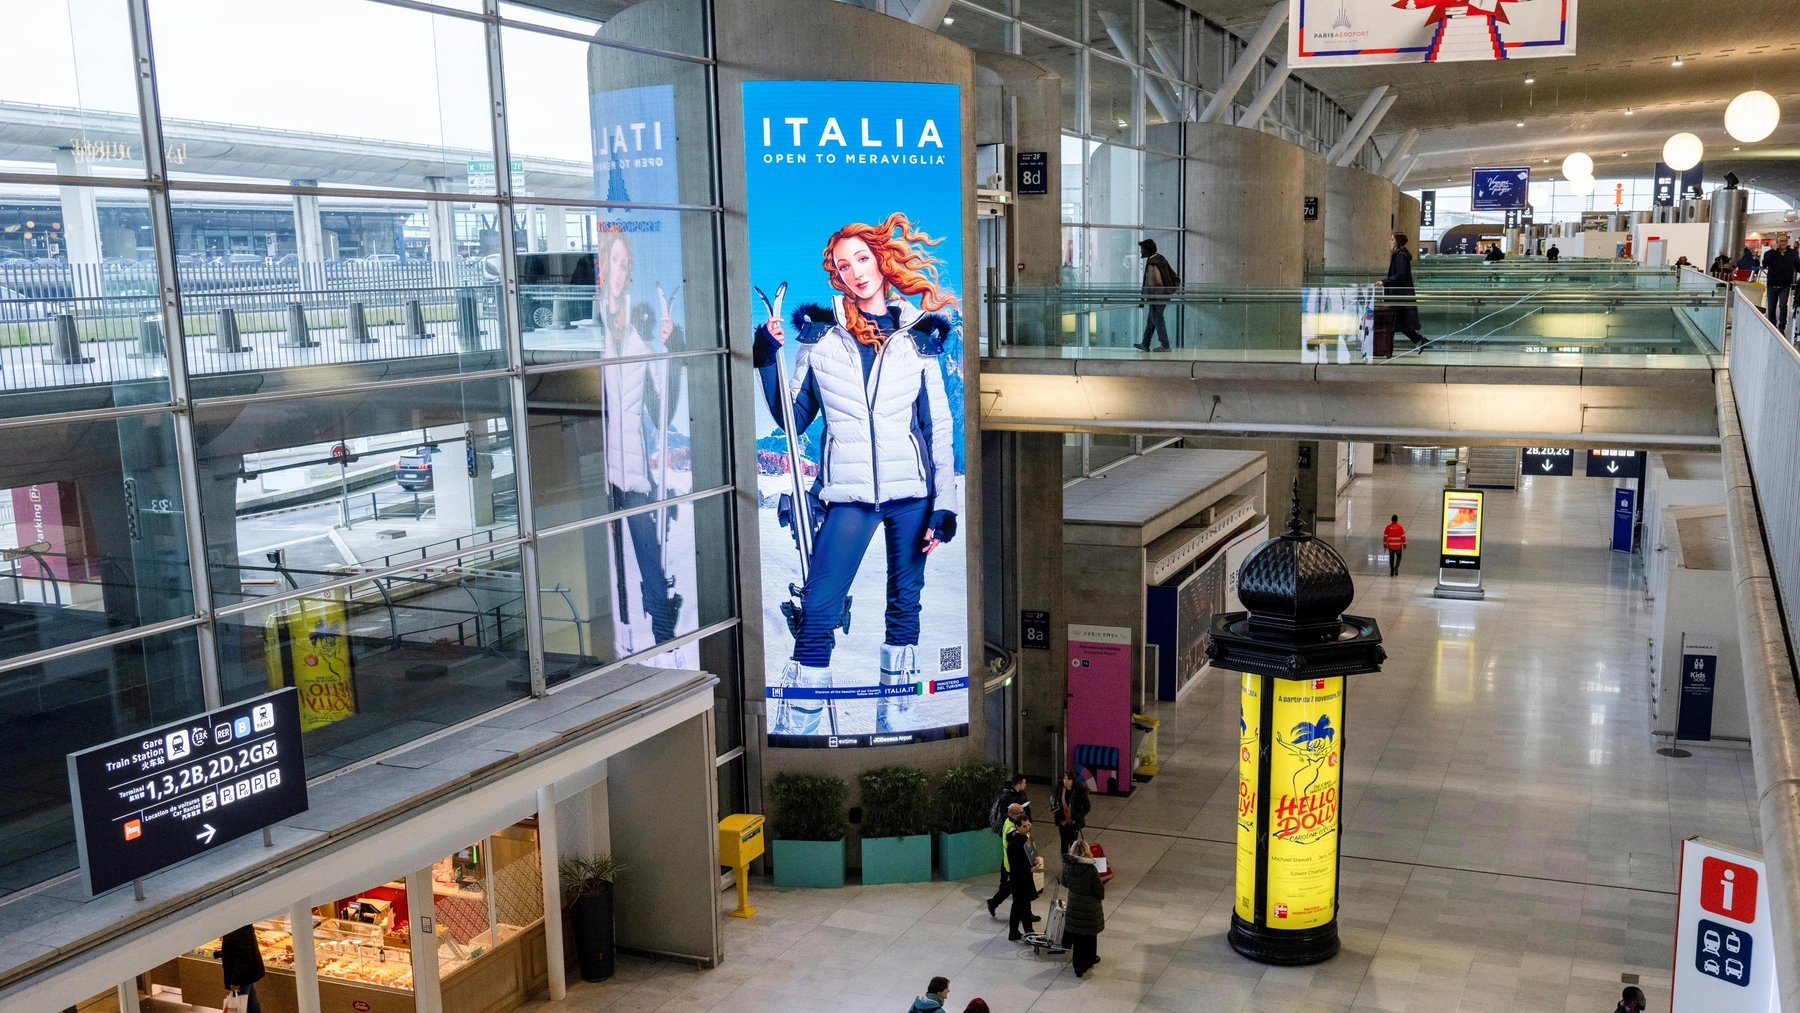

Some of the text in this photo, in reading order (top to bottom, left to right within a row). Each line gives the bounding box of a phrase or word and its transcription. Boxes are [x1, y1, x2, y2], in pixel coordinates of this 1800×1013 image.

[762, 117, 944, 148] ITALIA
[763, 153, 945, 165] OPEN TO MERAVIGLIA
[1023, 170, 1041, 185] 8d
[1027, 627, 1044, 641] 8a
[884, 686, 915, 694] ITALIA.IT
[1278, 695, 1283, 703] A
[1314, 692, 1337, 702] novembre
[194, 720, 272, 741] 13 RER B PARIS
[142, 738, 163, 750] Gare
[106, 747, 164, 772] Train Station
[119, 784, 145, 799] Terminal
[145, 809, 169, 822] Location
[177, 798, 200, 810] voitures
[172, 802, 201, 818] Car Rental
